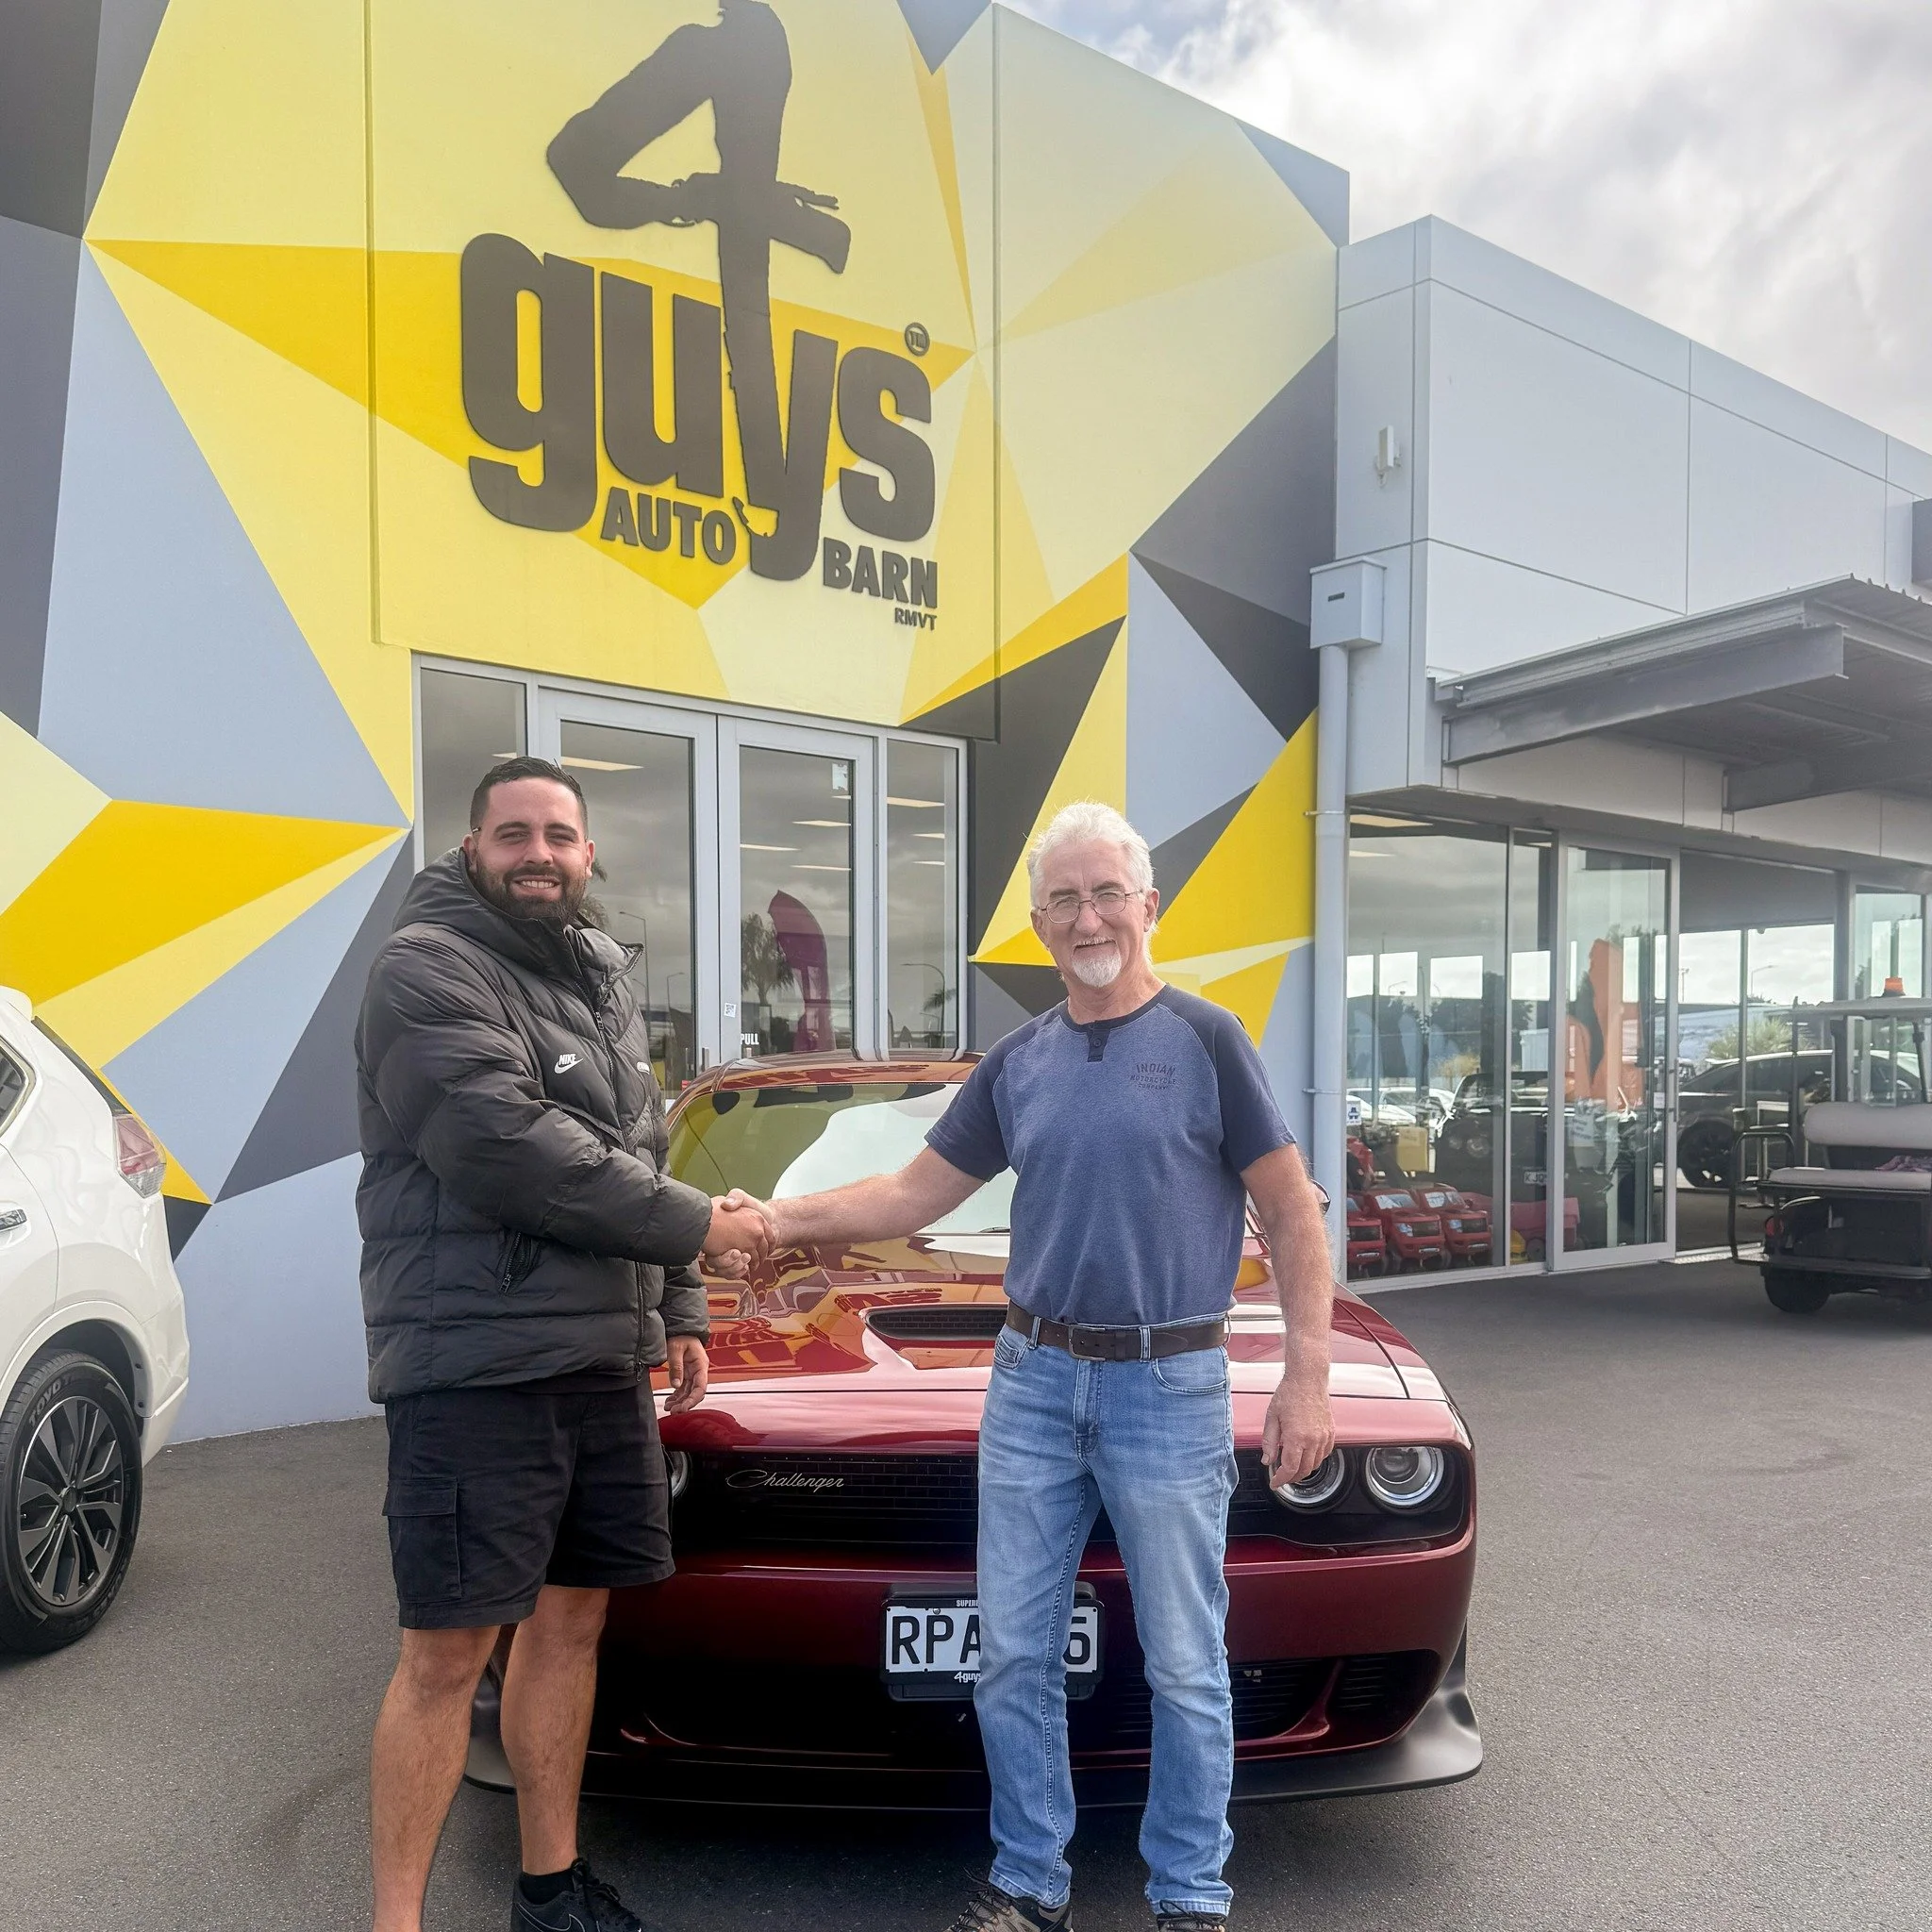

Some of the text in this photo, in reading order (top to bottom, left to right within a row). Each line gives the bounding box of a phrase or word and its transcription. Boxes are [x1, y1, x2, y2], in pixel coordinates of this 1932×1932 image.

[460, 232, 936, 581] guys
[601, 487, 938, 609] AUTO BARN
[893, 607, 937, 631] RMVT
[740, 1033, 759, 1045] PULL
[558, 1054, 576, 1065] NIKE
[1136, 1063, 1175, 1075] INDIAN
[28, 1377, 62, 1427] TOYO
[726, 1469, 844, 1493] Challenger
